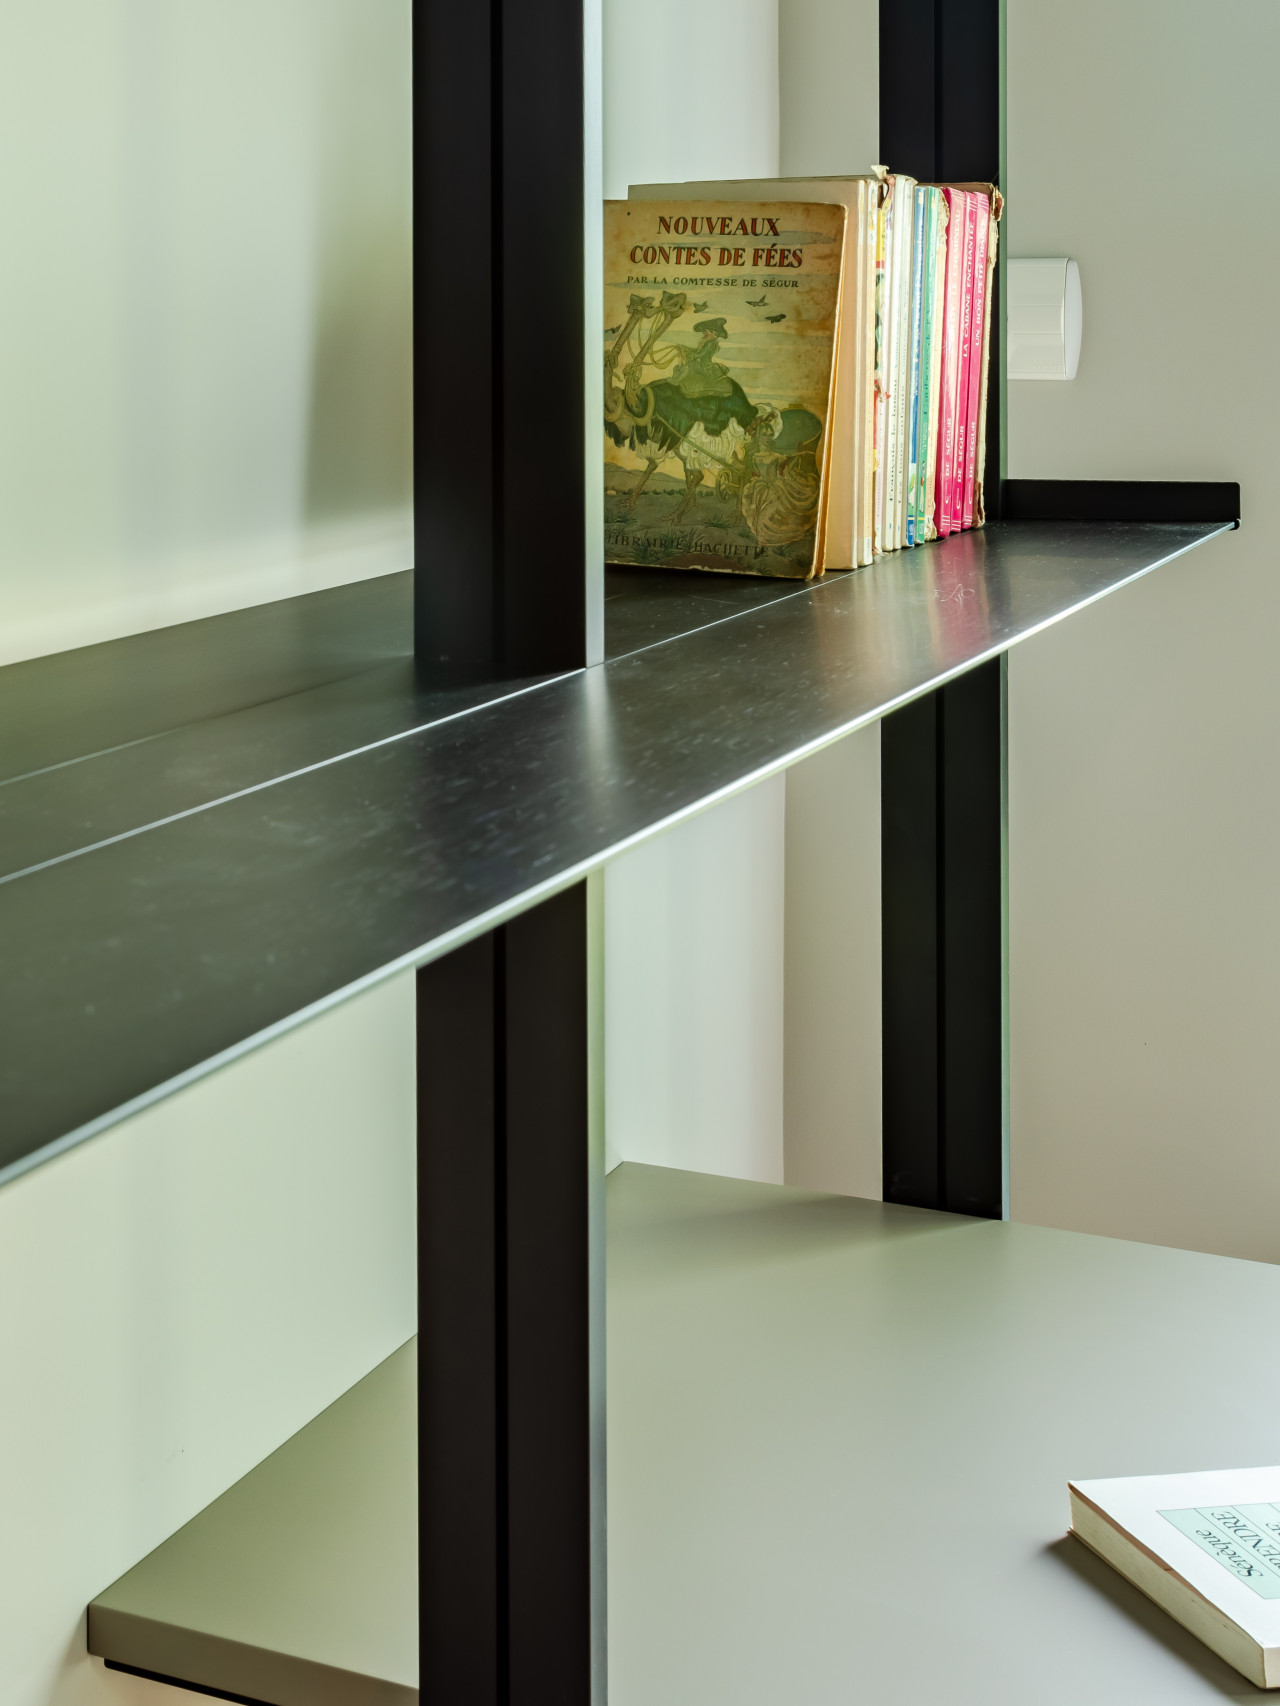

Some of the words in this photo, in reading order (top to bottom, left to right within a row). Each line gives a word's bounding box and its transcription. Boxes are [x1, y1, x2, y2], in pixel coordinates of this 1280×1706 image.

[657, 216, 780, 237] NOUVEAUX
[629, 245, 712, 266] CONTES
[718, 247, 746, 267] DE
[751, 243, 803, 269] FÉES
[626, 275, 648, 284] PAR
[653, 276, 668, 285] LA
[673, 277, 737, 287] COMTESSE
[742, 279, 757, 287] DE
[761, 277, 799, 288] SÉGUR
[606, 533, 685, 550] LIBRAIRIE
[1196, 1529, 1264, 1577] Sénèque
